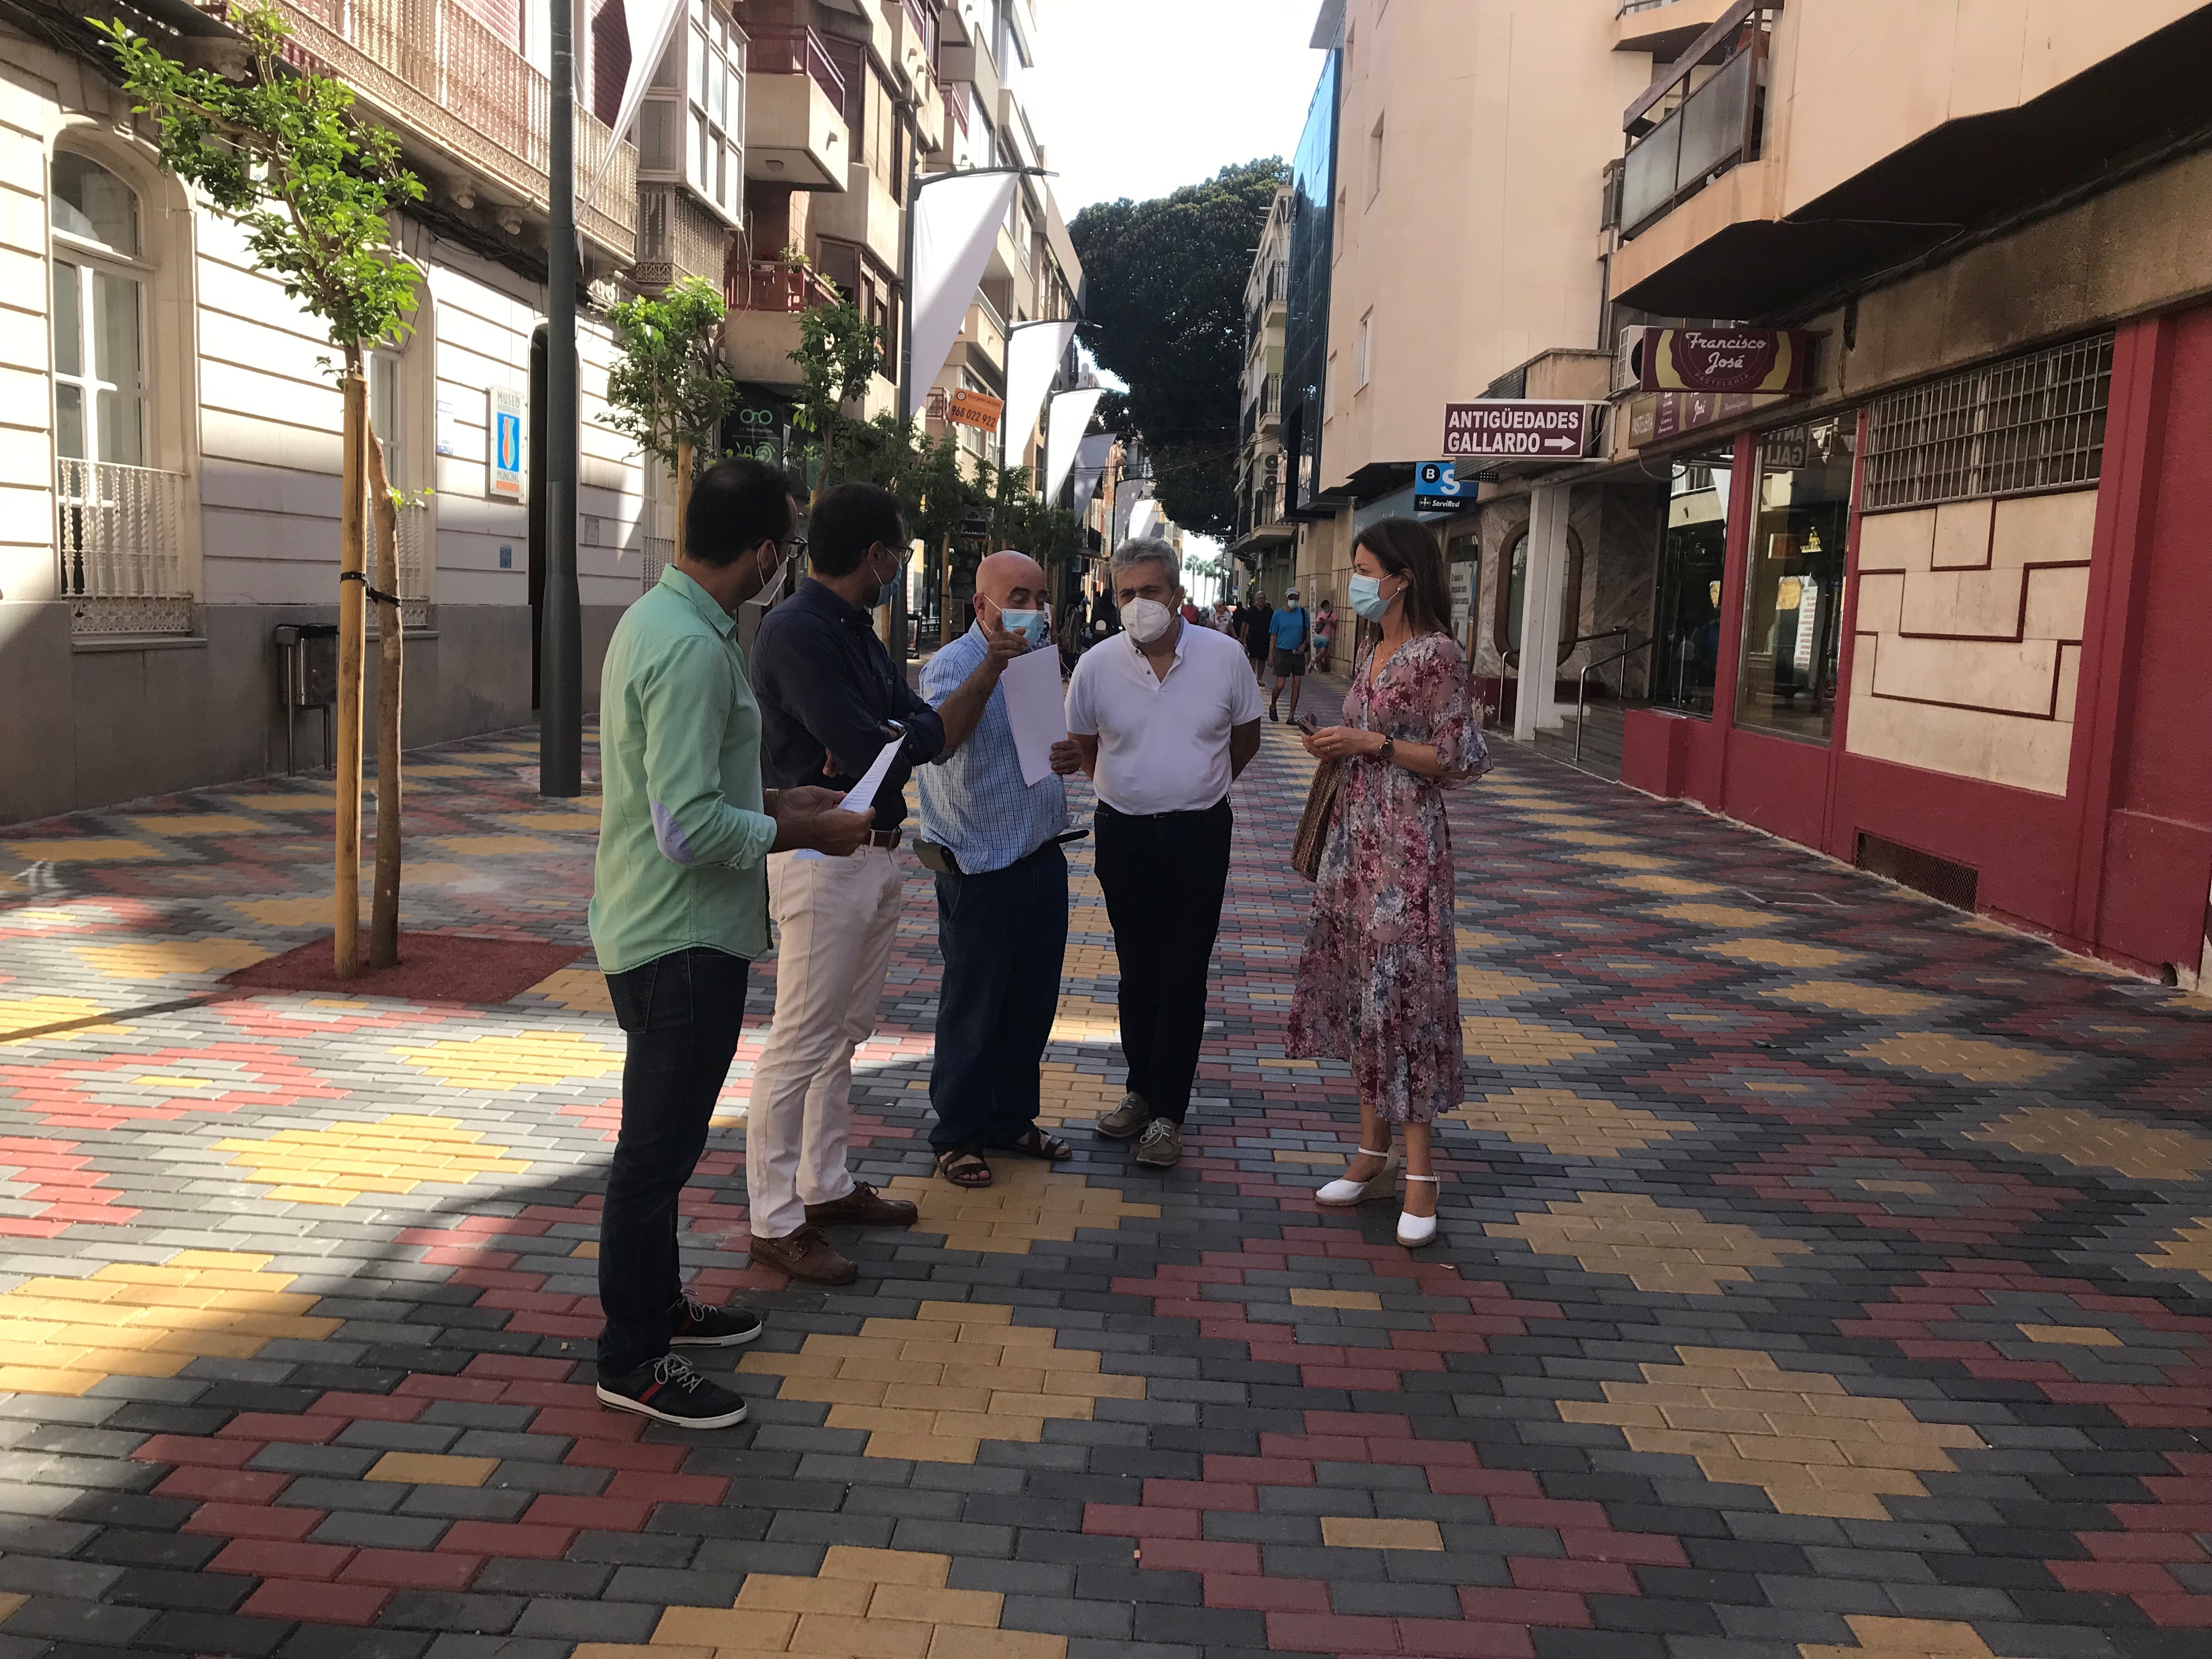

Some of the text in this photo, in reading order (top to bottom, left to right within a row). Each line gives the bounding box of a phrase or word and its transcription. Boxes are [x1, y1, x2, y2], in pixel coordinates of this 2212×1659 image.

[1685, 332, 1767, 349] Francisco
[1705, 351, 1745, 374] José
[497, 391, 520, 408] MUSEO
[952, 405, 996, 427] 968 022 922
[1448, 408, 1579, 429] ANTIGÜEDADES
[1448, 432, 1541, 453] GALLARDO
[497, 470, 519, 483] MUNICIPAL
[1426, 469, 1460, 495] B S
